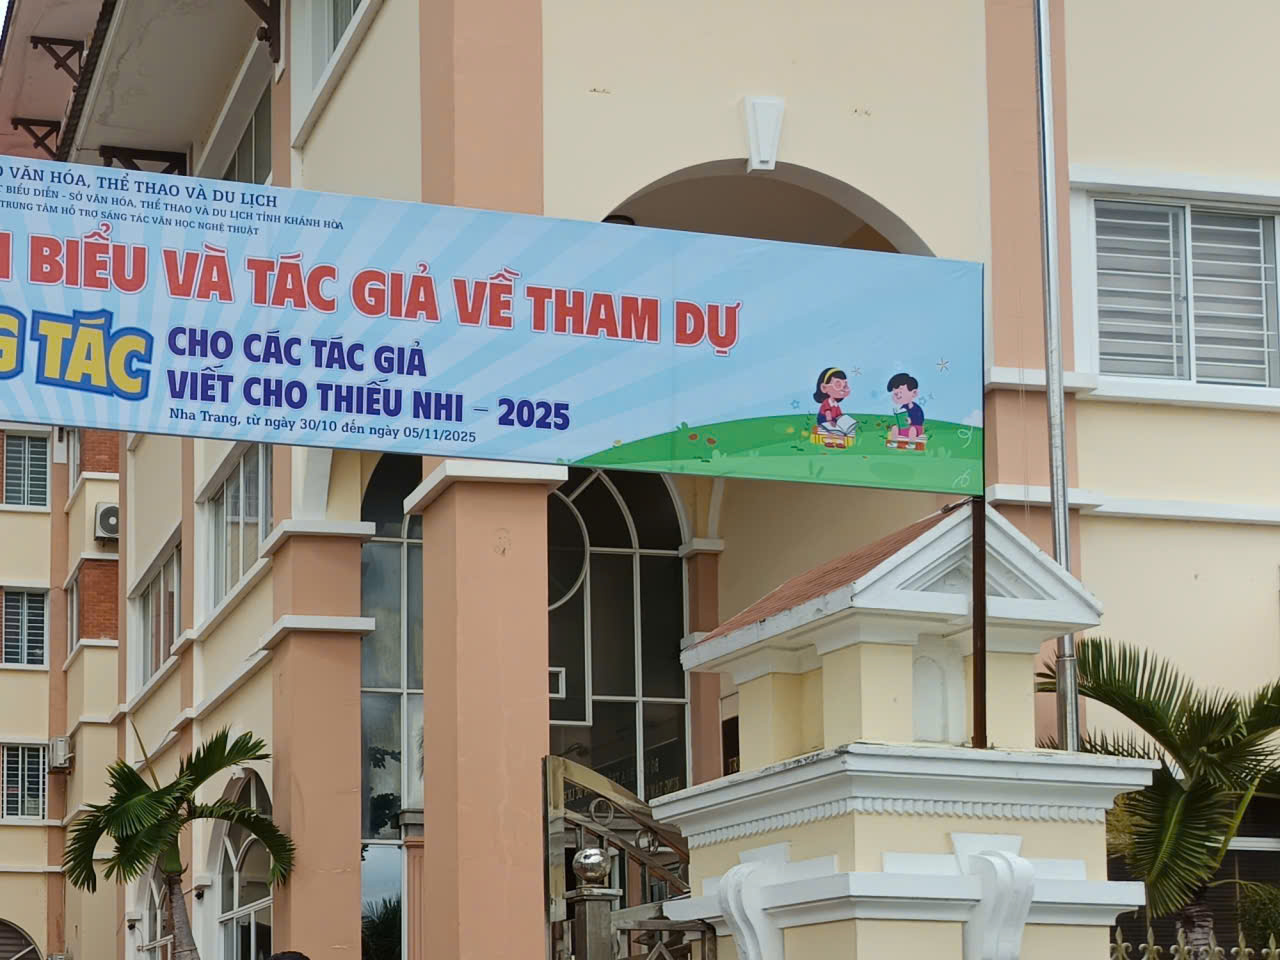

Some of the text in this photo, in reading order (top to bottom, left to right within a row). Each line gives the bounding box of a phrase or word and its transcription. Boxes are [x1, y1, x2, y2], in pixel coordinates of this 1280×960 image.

[9, 164, 45, 181] VĂN
[50, 168, 91, 189] HÓA,
[96, 172, 129, 191] THỂ
[134, 180, 180, 197] THAO
[185, 184, 208, 200] VÀ
[213, 190, 236, 203] DU
[241, 193, 278, 208] LỊCH
[28, 222, 148, 293] BIỂU
[162, 241, 235, 303] VÀ
[245, 251, 338, 313] TÁC
[351, 261, 441, 322] GIẢ
[452, 266, 521, 329] VỀ
[524, 284, 661, 344] THAM
[673, 299, 742, 357] DỰ
[35, 313, 150, 396] TÁC
[167, 326, 427, 377] CHO CÁC TÁC GIẢ
[167, 364, 234, 403] VIẾT
[243, 377, 308, 409] CHO
[317, 379, 402, 417] THIẾU
[413, 390, 463, 422] NHI
[497, 398, 570, 431] 2025
[169, 408, 477, 443] Nha Trang, từ ngày 30/10 đến ngày 05/11/2025
